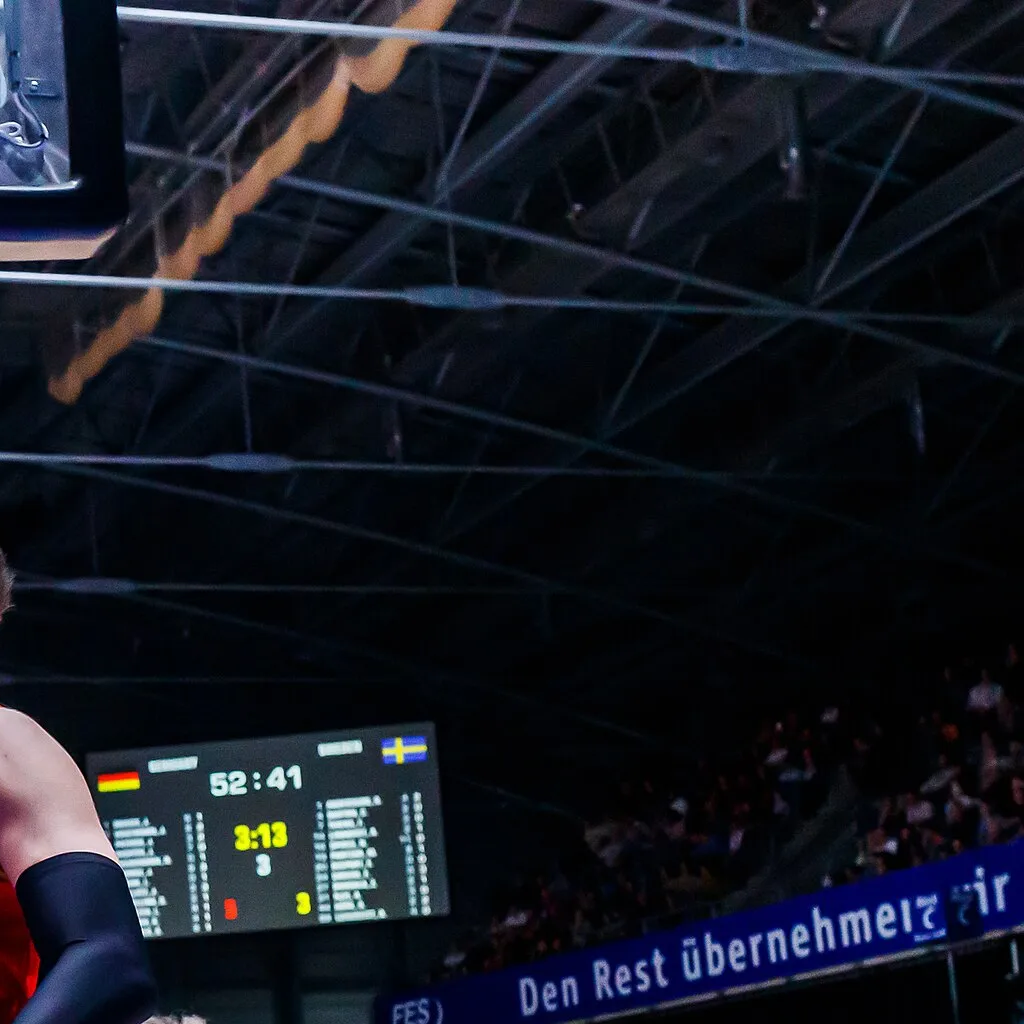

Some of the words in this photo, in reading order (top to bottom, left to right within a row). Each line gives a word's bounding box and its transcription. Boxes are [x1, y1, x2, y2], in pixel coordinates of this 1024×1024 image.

[234, 820, 288, 851] 3:13
[518, 976, 579, 1017] Den
[592, 947, 669, 1000] Rest
[962, 865, 1011, 917] ir
